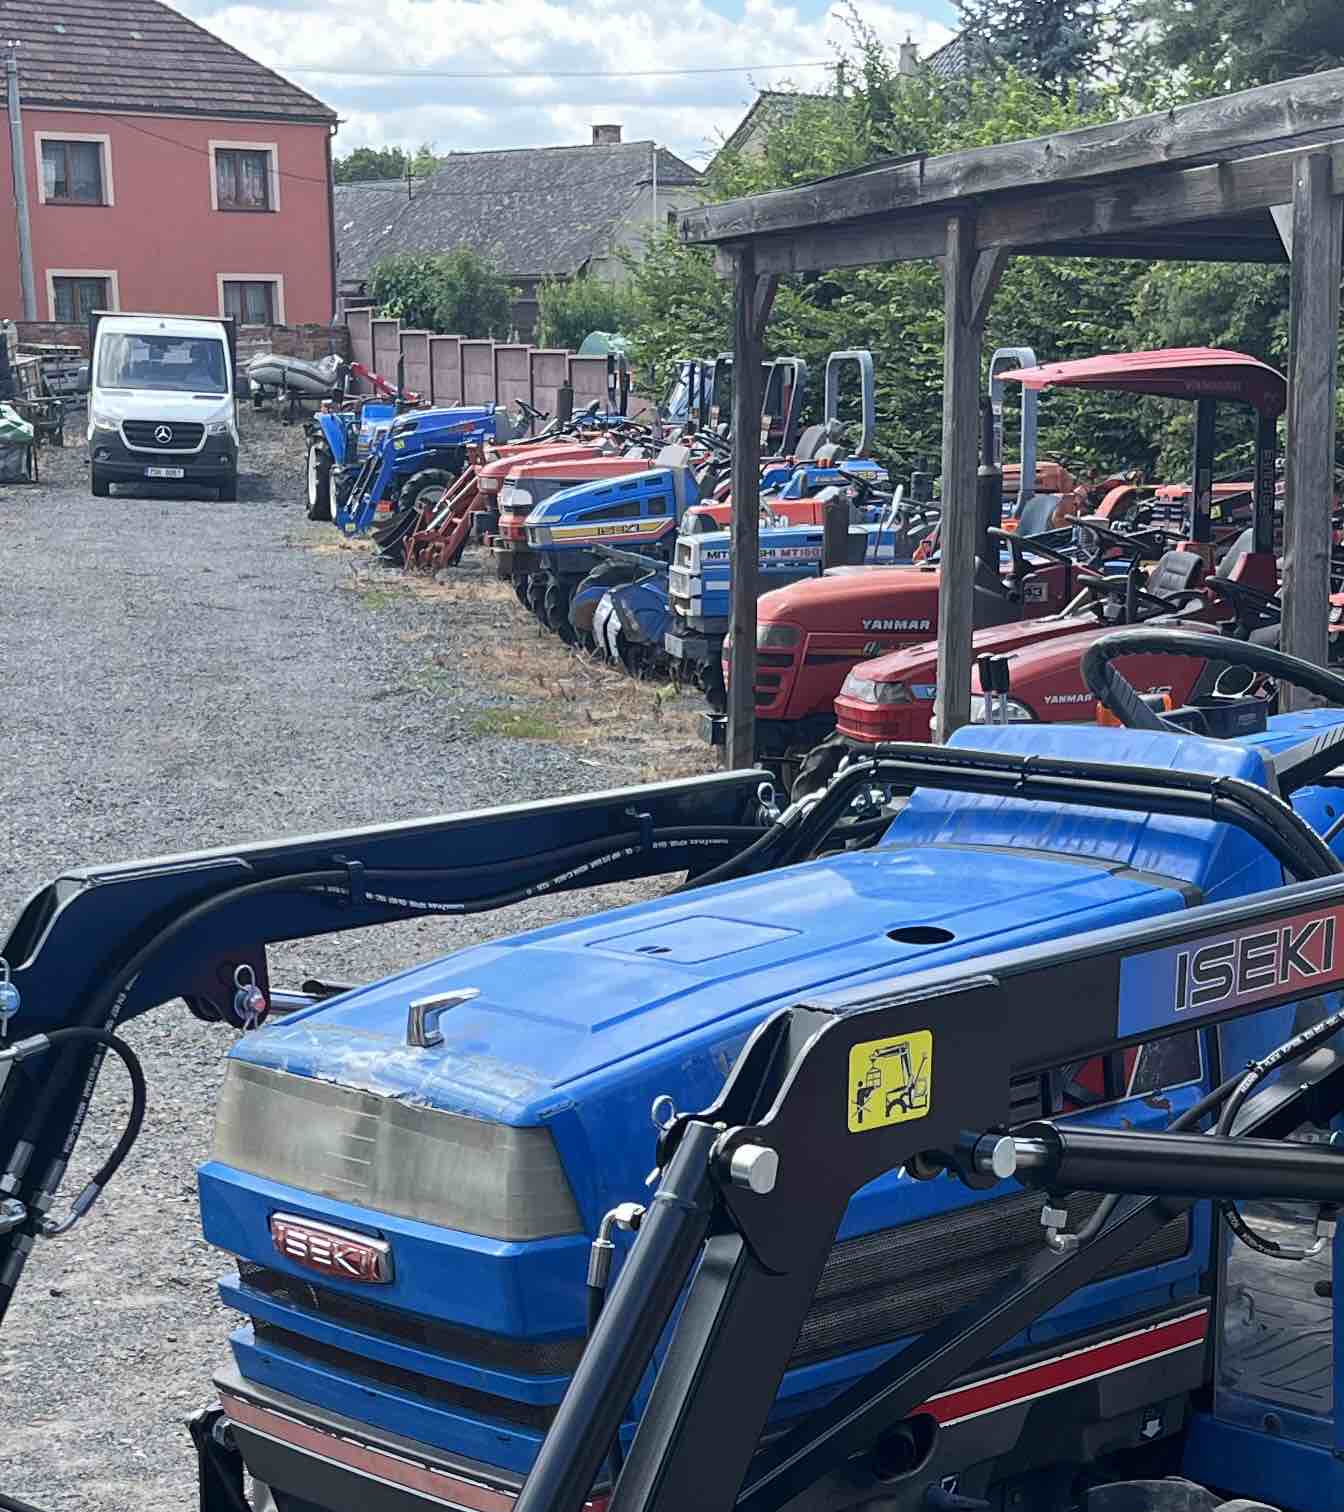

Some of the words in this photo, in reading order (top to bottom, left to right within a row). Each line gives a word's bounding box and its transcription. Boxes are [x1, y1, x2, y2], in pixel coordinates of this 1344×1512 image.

[862, 619, 930, 631] YANMAR
[1174, 915, 1337, 1012] ISEKI
[277, 1224, 370, 1276] ISEKI
